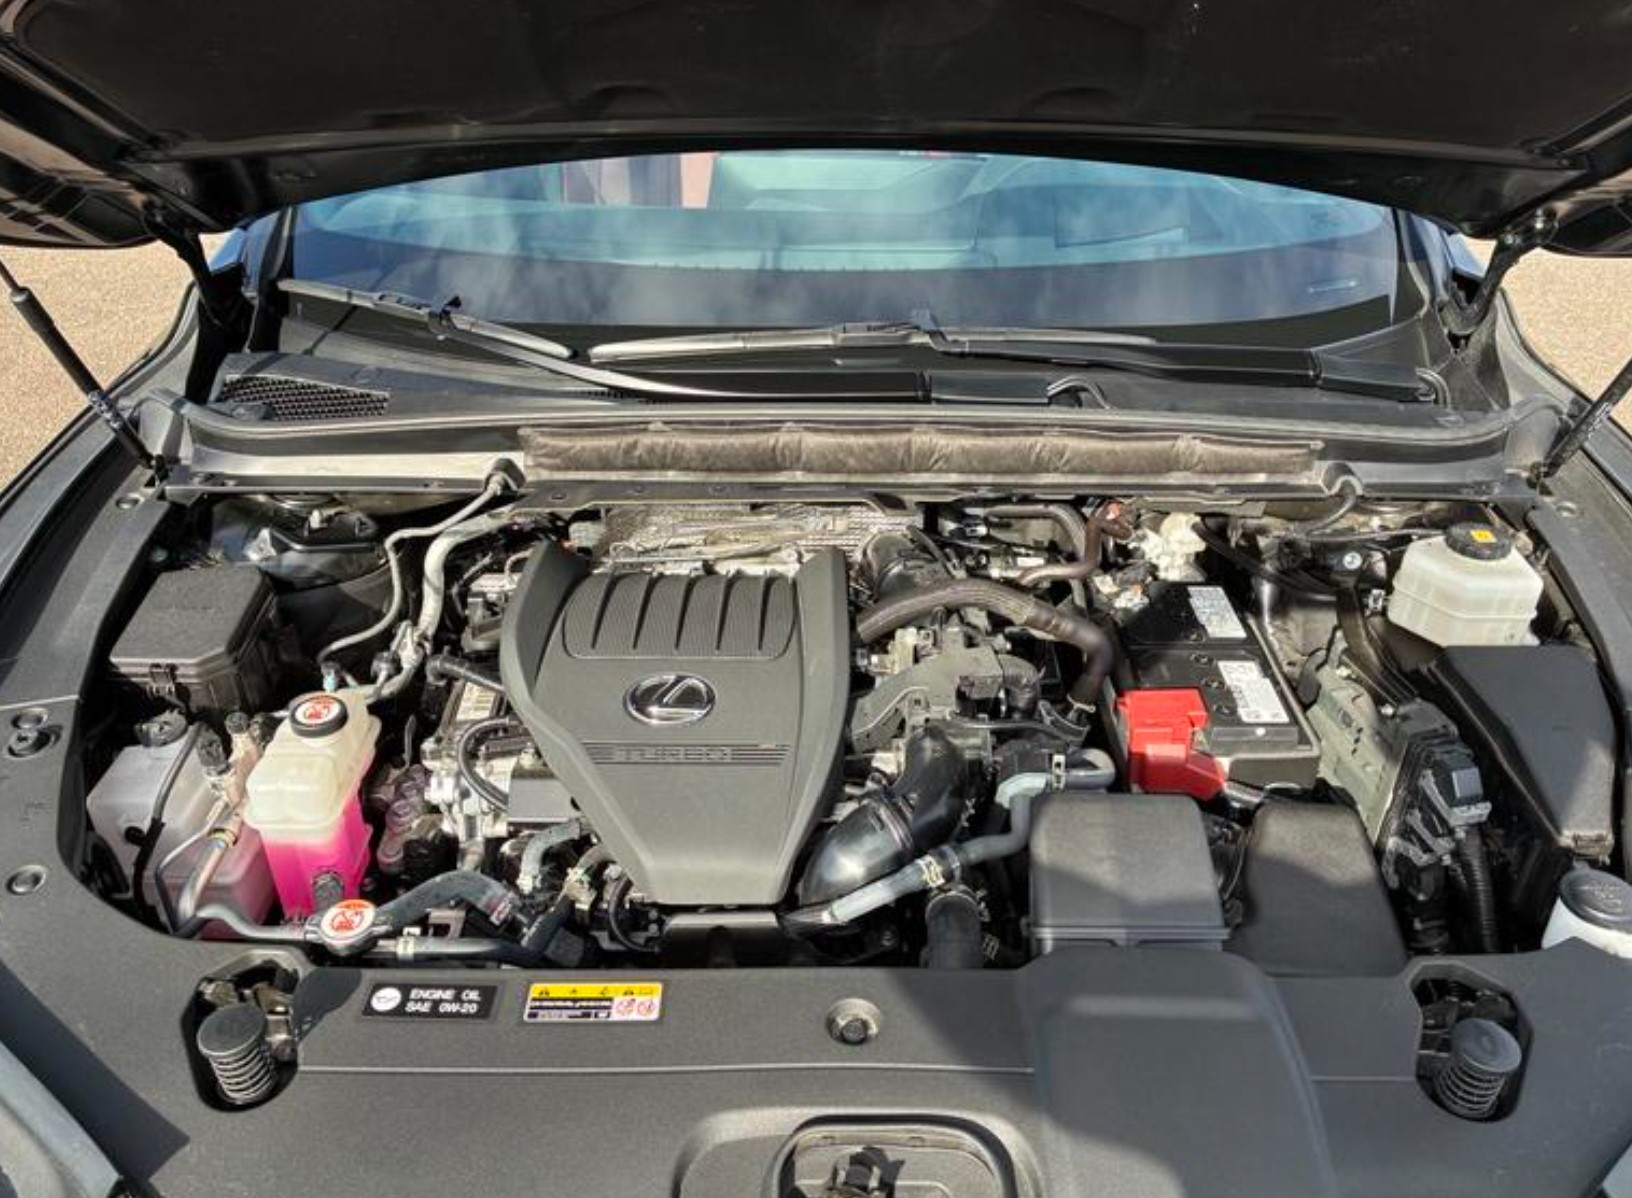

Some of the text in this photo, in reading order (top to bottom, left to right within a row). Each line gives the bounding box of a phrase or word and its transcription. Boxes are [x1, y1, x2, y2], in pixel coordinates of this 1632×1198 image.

[616, 746, 728, 762] TURBO
[409, 988, 456, 1000] ENGINE
[461, 989, 481, 1001] OIL
[404, 1001, 432, 1013] SAE
